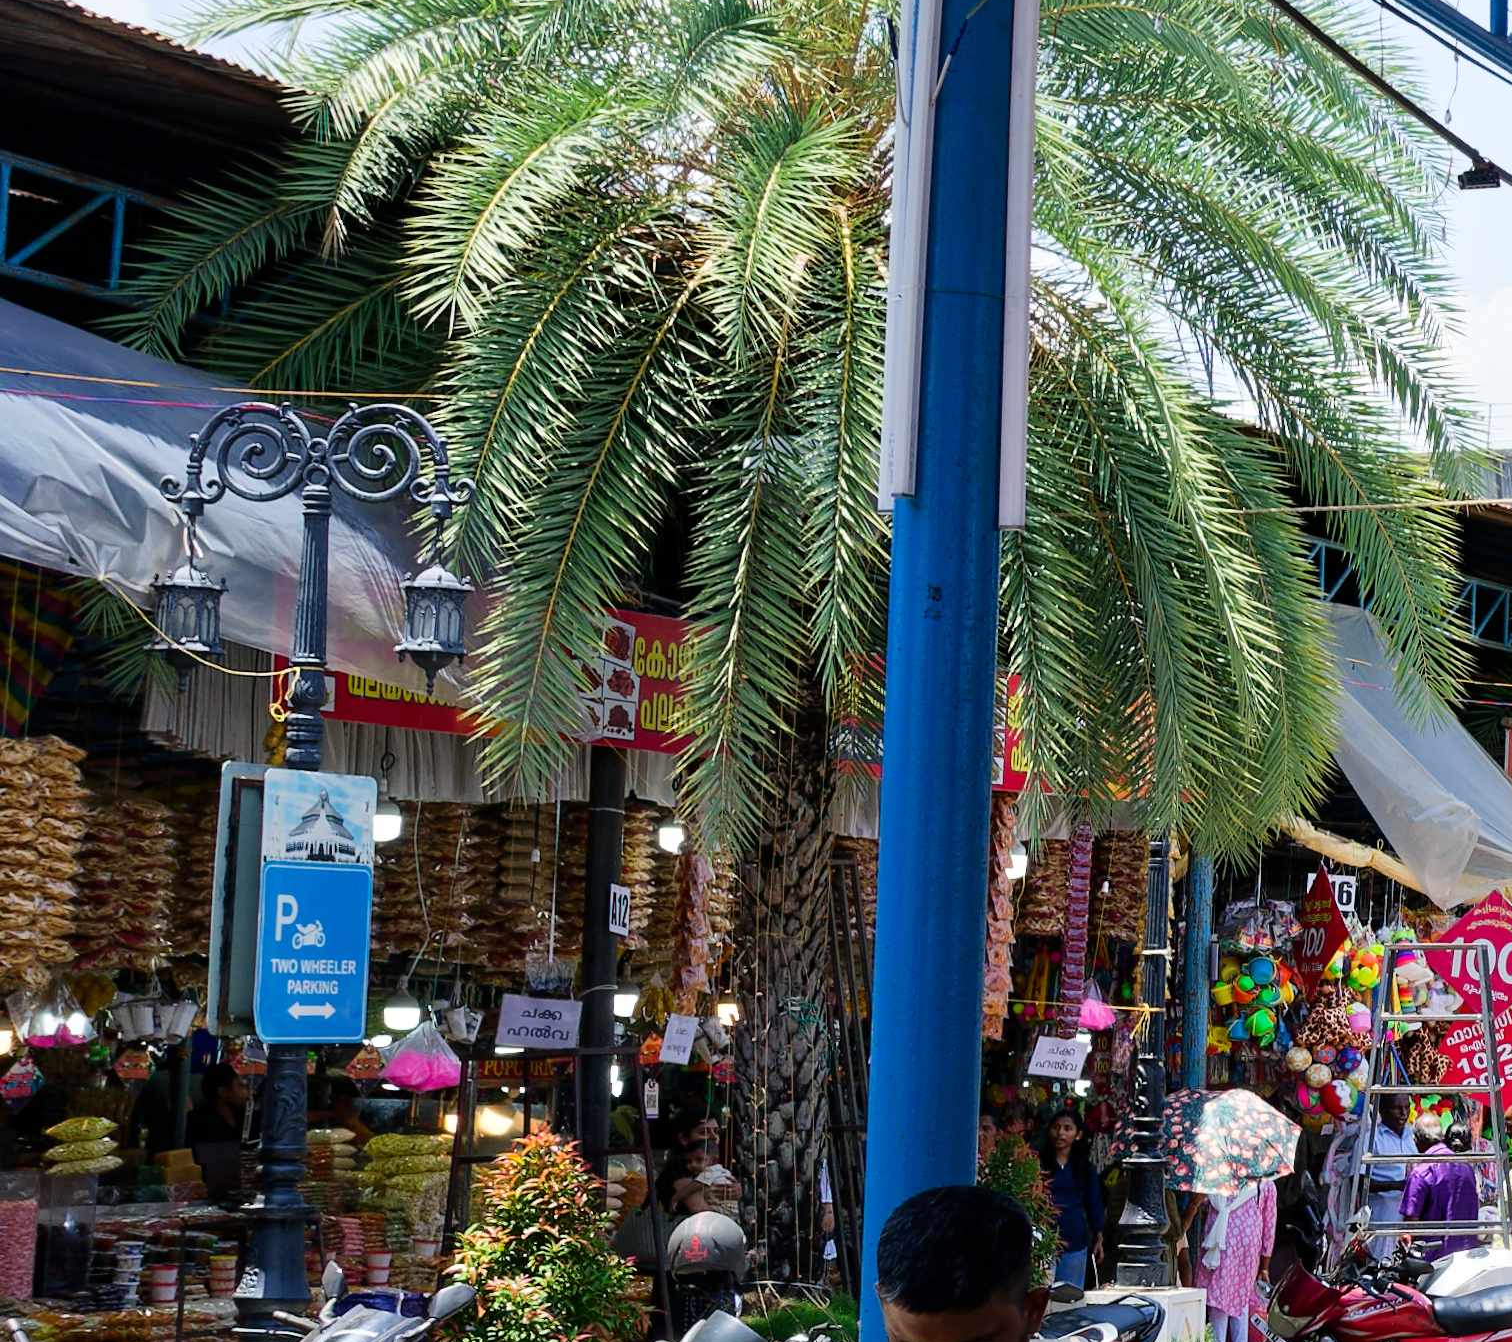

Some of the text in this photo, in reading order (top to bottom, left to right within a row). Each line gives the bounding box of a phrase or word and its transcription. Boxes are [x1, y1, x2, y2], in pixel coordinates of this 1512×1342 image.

[274, 894, 298, 942] P
[611, 892, 629, 929] A12
[1302, 927, 1326, 958] 100
[270, 958, 357, 975] TWO WHEELER
[287, 979, 339, 995] PARKING
